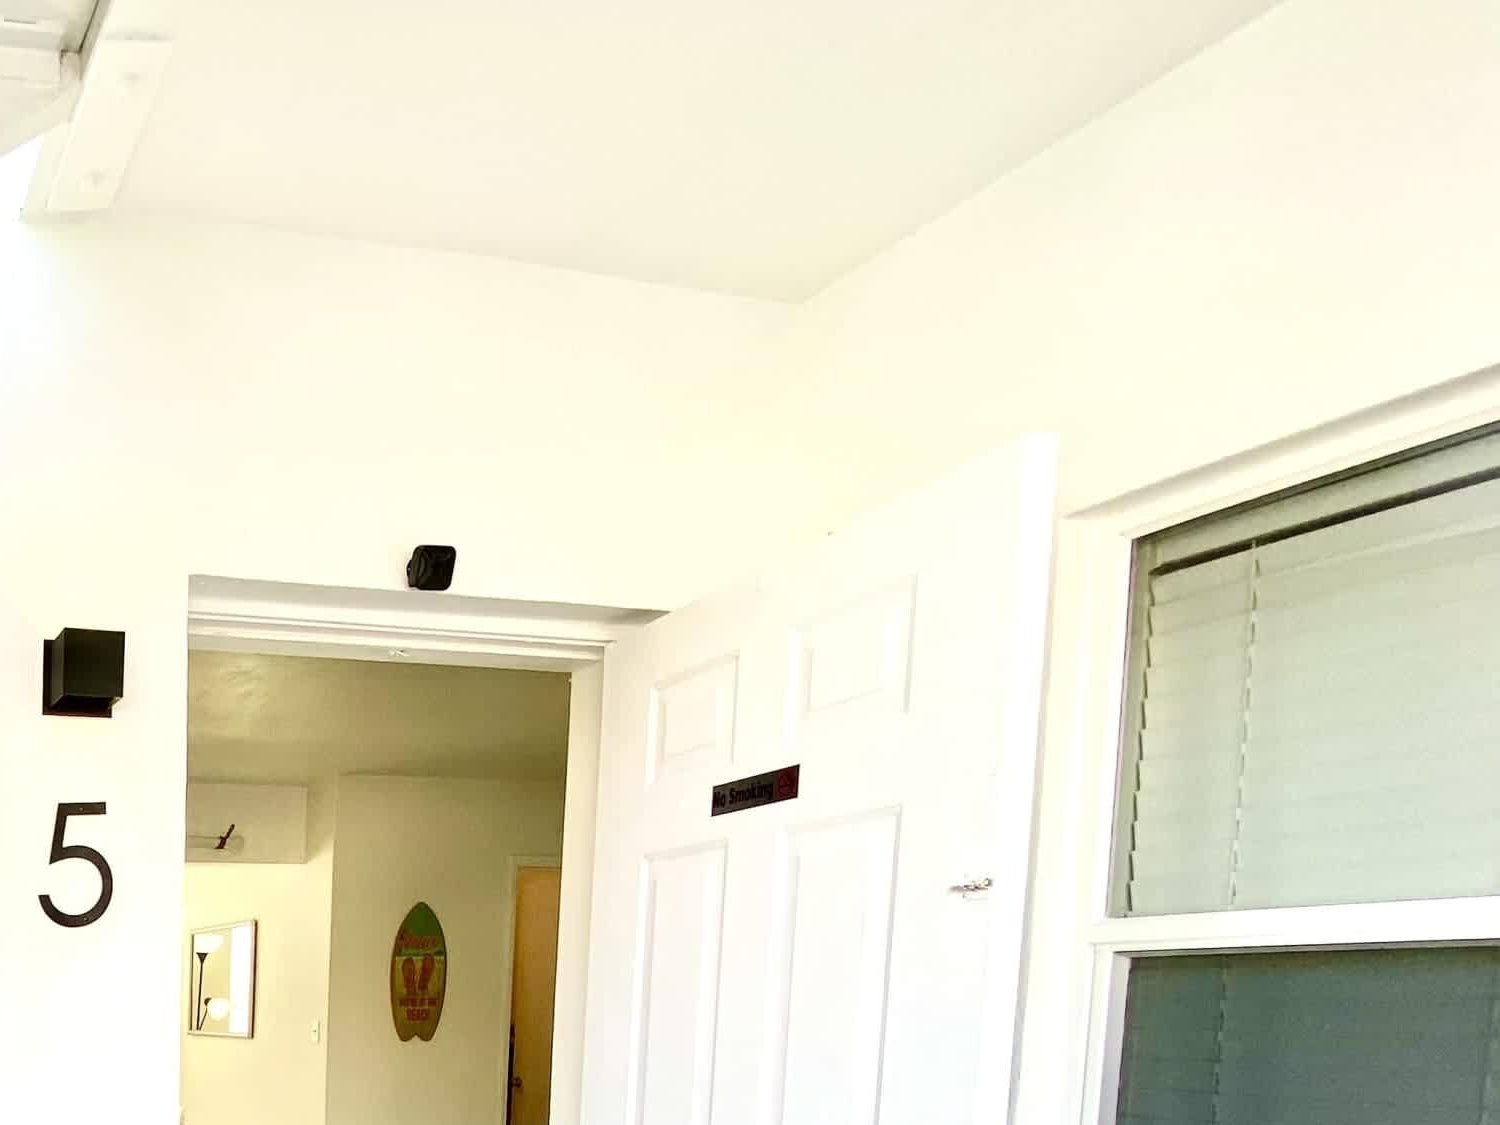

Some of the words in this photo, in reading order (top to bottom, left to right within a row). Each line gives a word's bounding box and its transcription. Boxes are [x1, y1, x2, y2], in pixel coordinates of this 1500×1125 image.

[713, 790, 726, 808] No
[729, 780, 773, 804] Smoking
[38, 801, 114, 928] 5
